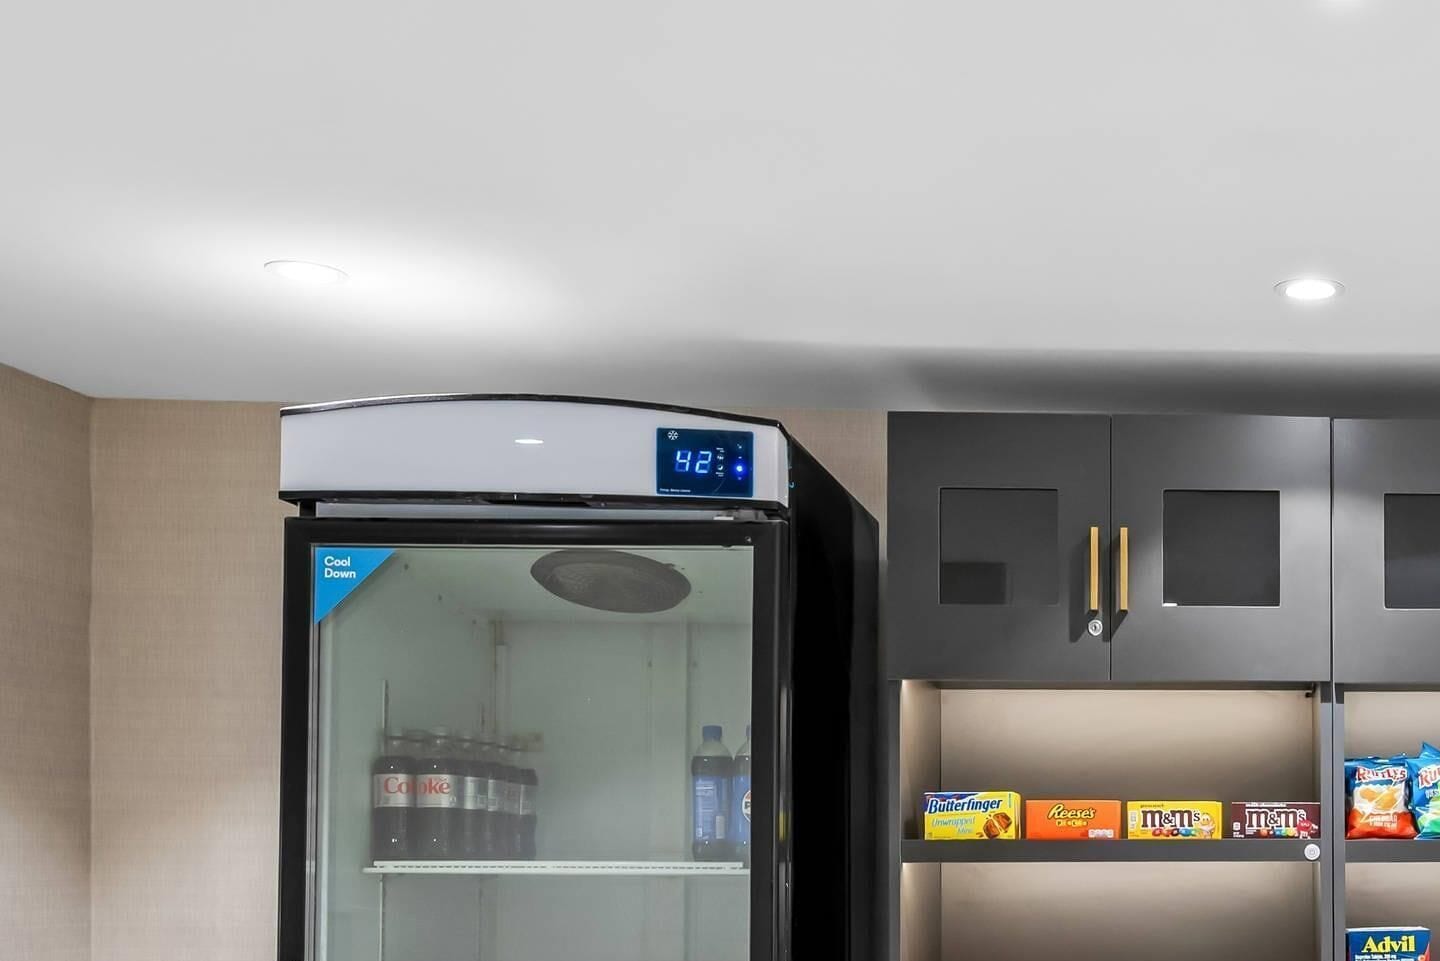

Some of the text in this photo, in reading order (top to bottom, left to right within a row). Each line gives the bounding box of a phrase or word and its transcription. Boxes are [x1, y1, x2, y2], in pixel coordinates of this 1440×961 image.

[675, 450, 712, 473] 42
[324, 556, 351, 567] Cool
[324, 568, 357, 579] Down
[928, 798, 1003, 814] Butterfinger
[1047, 803, 1096, 820] Reese's
[1361, 935, 1416, 953] Advil
